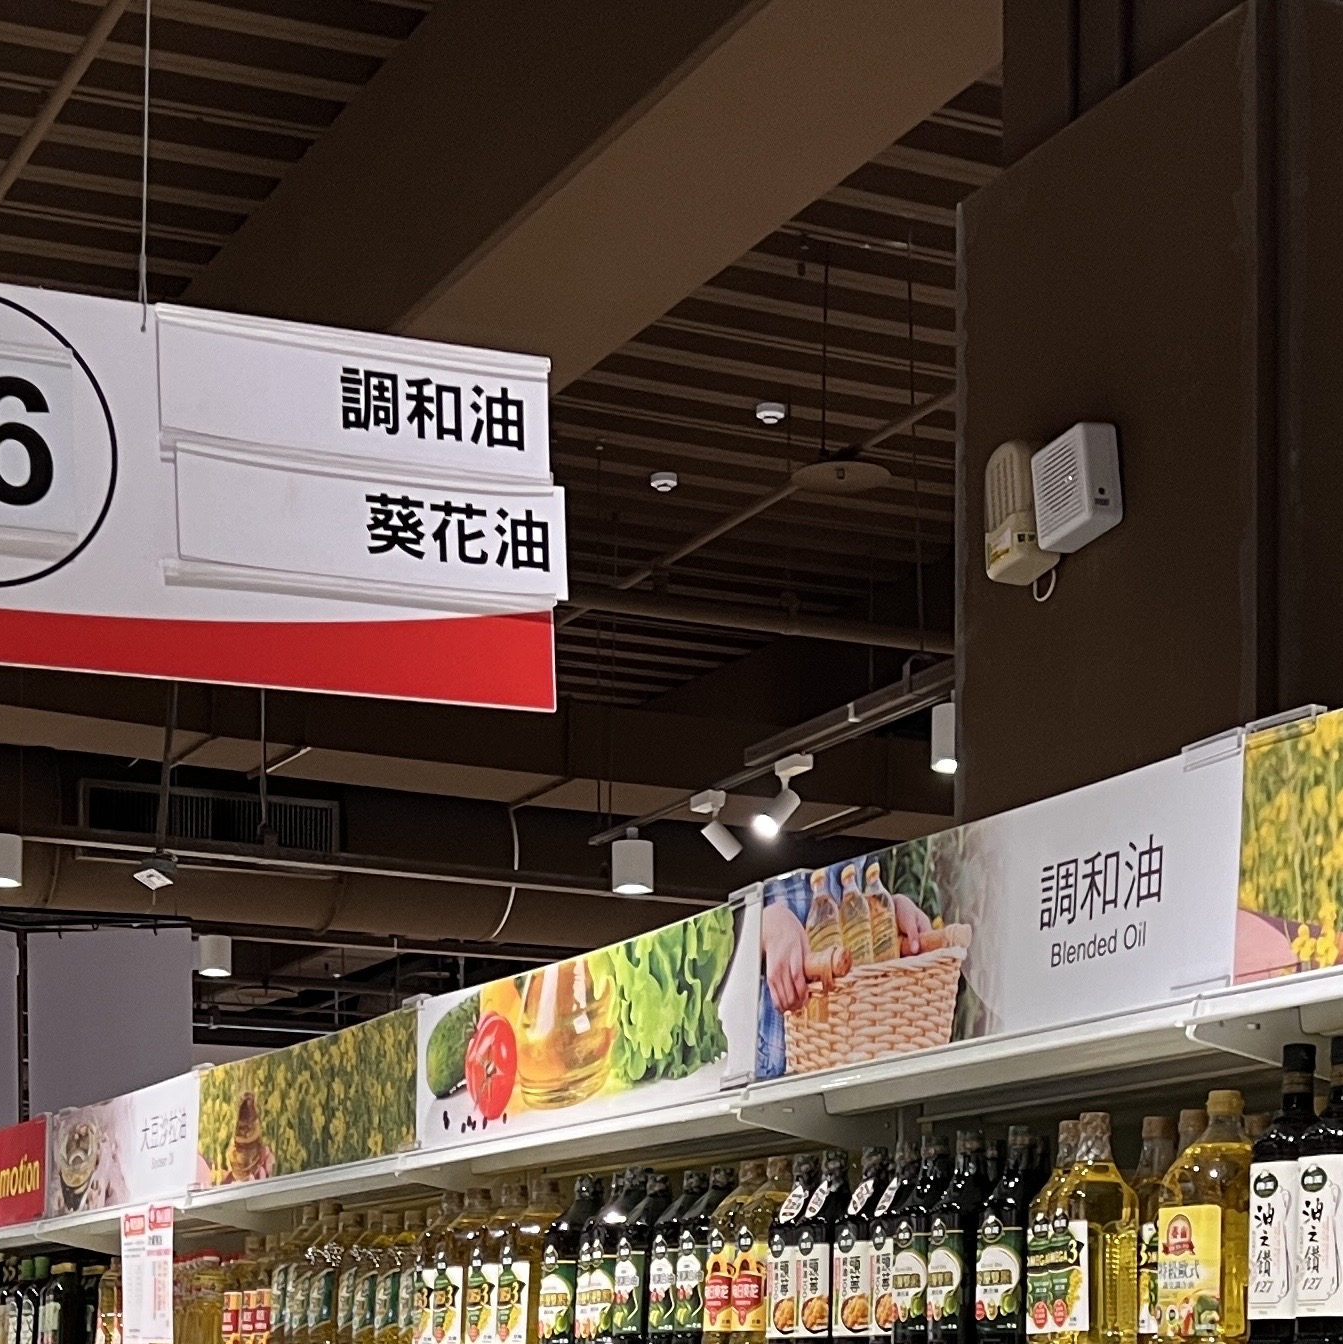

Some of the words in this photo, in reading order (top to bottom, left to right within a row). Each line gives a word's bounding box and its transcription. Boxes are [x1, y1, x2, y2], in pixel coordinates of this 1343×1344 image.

[340, 366, 526, 452] 調和油
[366, 493, 551, 573] 葵花油
[1039, 833, 1164, 932] 調和油
[1050, 924, 1118, 968] Blended
[1123, 921, 1147, 949] Oil
